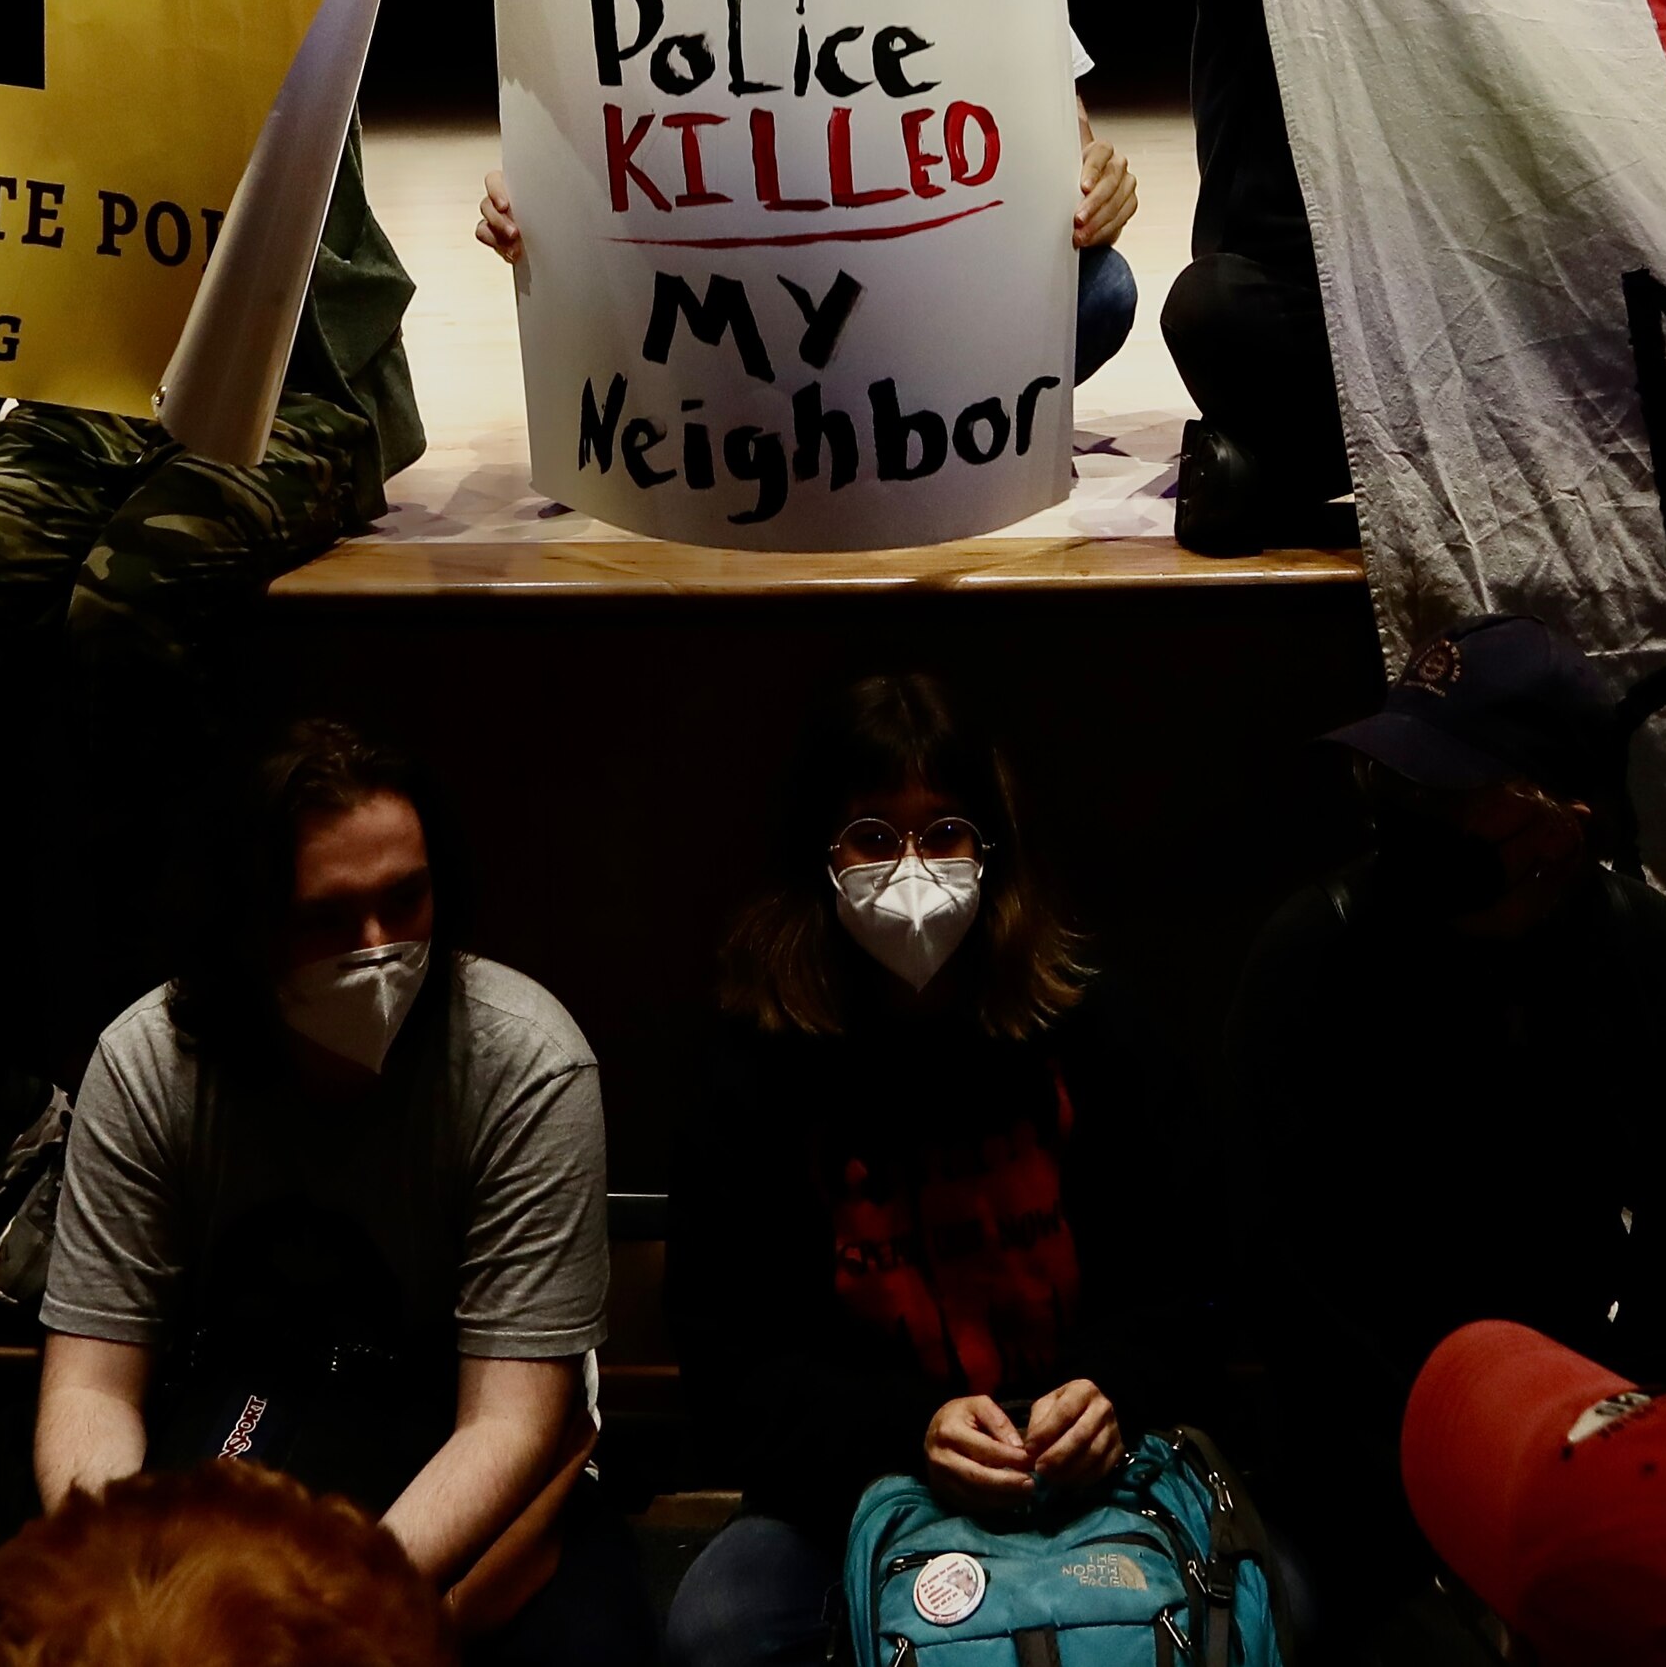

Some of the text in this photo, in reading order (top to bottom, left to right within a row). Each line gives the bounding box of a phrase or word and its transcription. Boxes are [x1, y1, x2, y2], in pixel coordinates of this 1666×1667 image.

[603, 100, 1002, 212] KILLED
[641, 269, 867, 383] MY
[578, 371, 1061, 525] Neighbor
[1060, 1564, 1119, 1577] NORTH
[1079, 1575, 1121, 1588] FACE
[1086, 1553, 1118, 1565] THE
